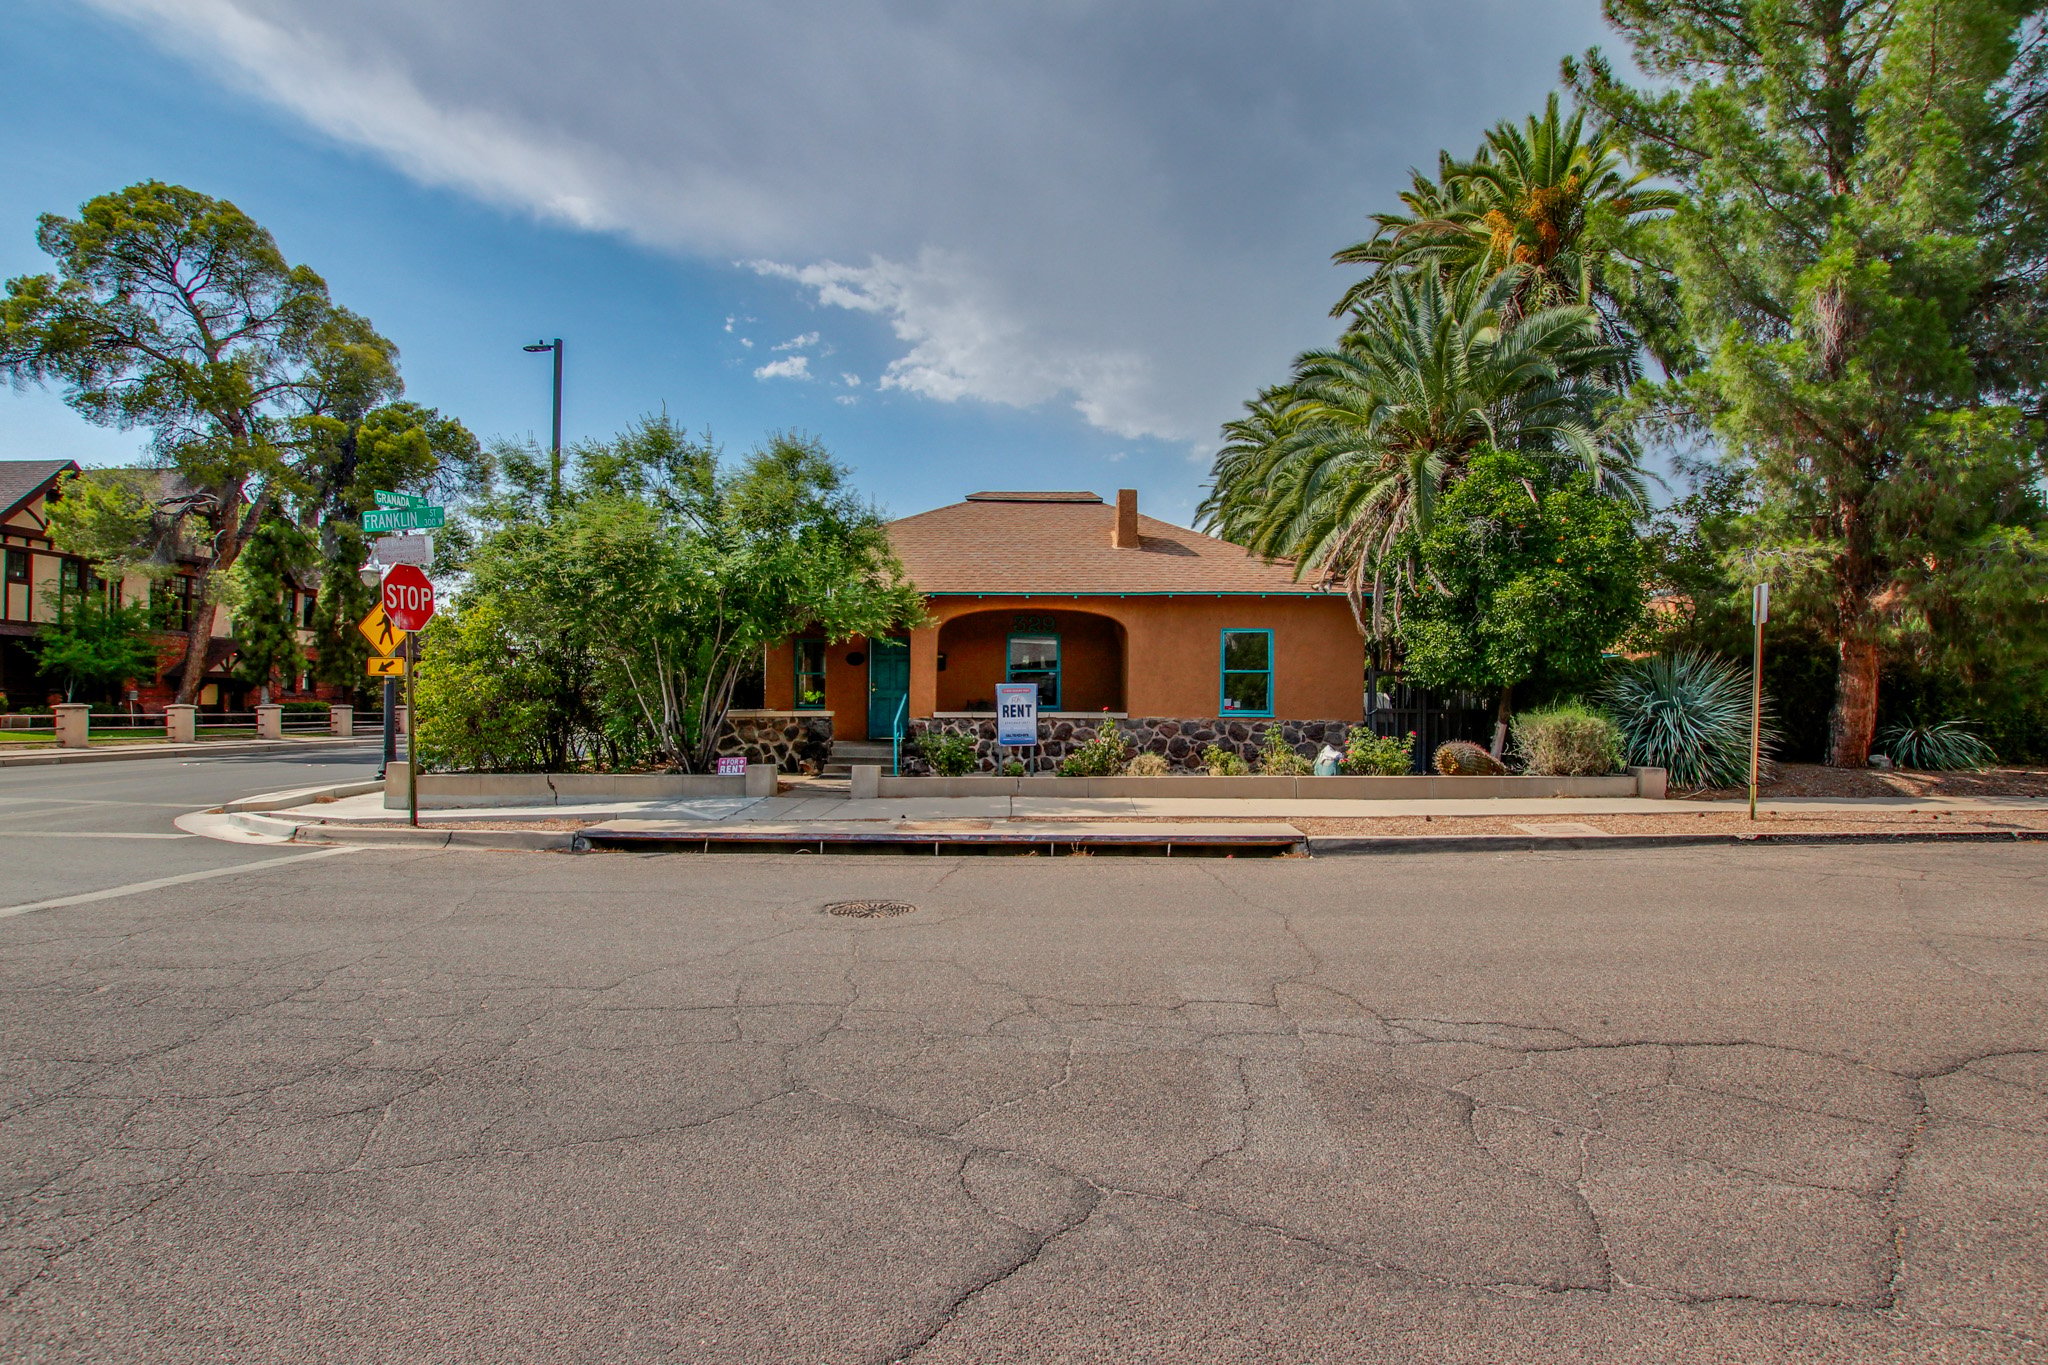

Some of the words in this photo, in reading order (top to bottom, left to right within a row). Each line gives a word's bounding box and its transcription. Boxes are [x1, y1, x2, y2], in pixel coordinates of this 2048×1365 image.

[376, 492, 410, 508] GRANADA
[364, 511, 418, 529] FRANKLIN
[429, 509, 436, 517] ST
[423, 518, 436, 527] 300
[386, 583, 432, 611] STOP
[1013, 615, 1056, 632] 329
[1002, 704, 1032, 718] RENT
[720, 765, 744, 773] RENT
